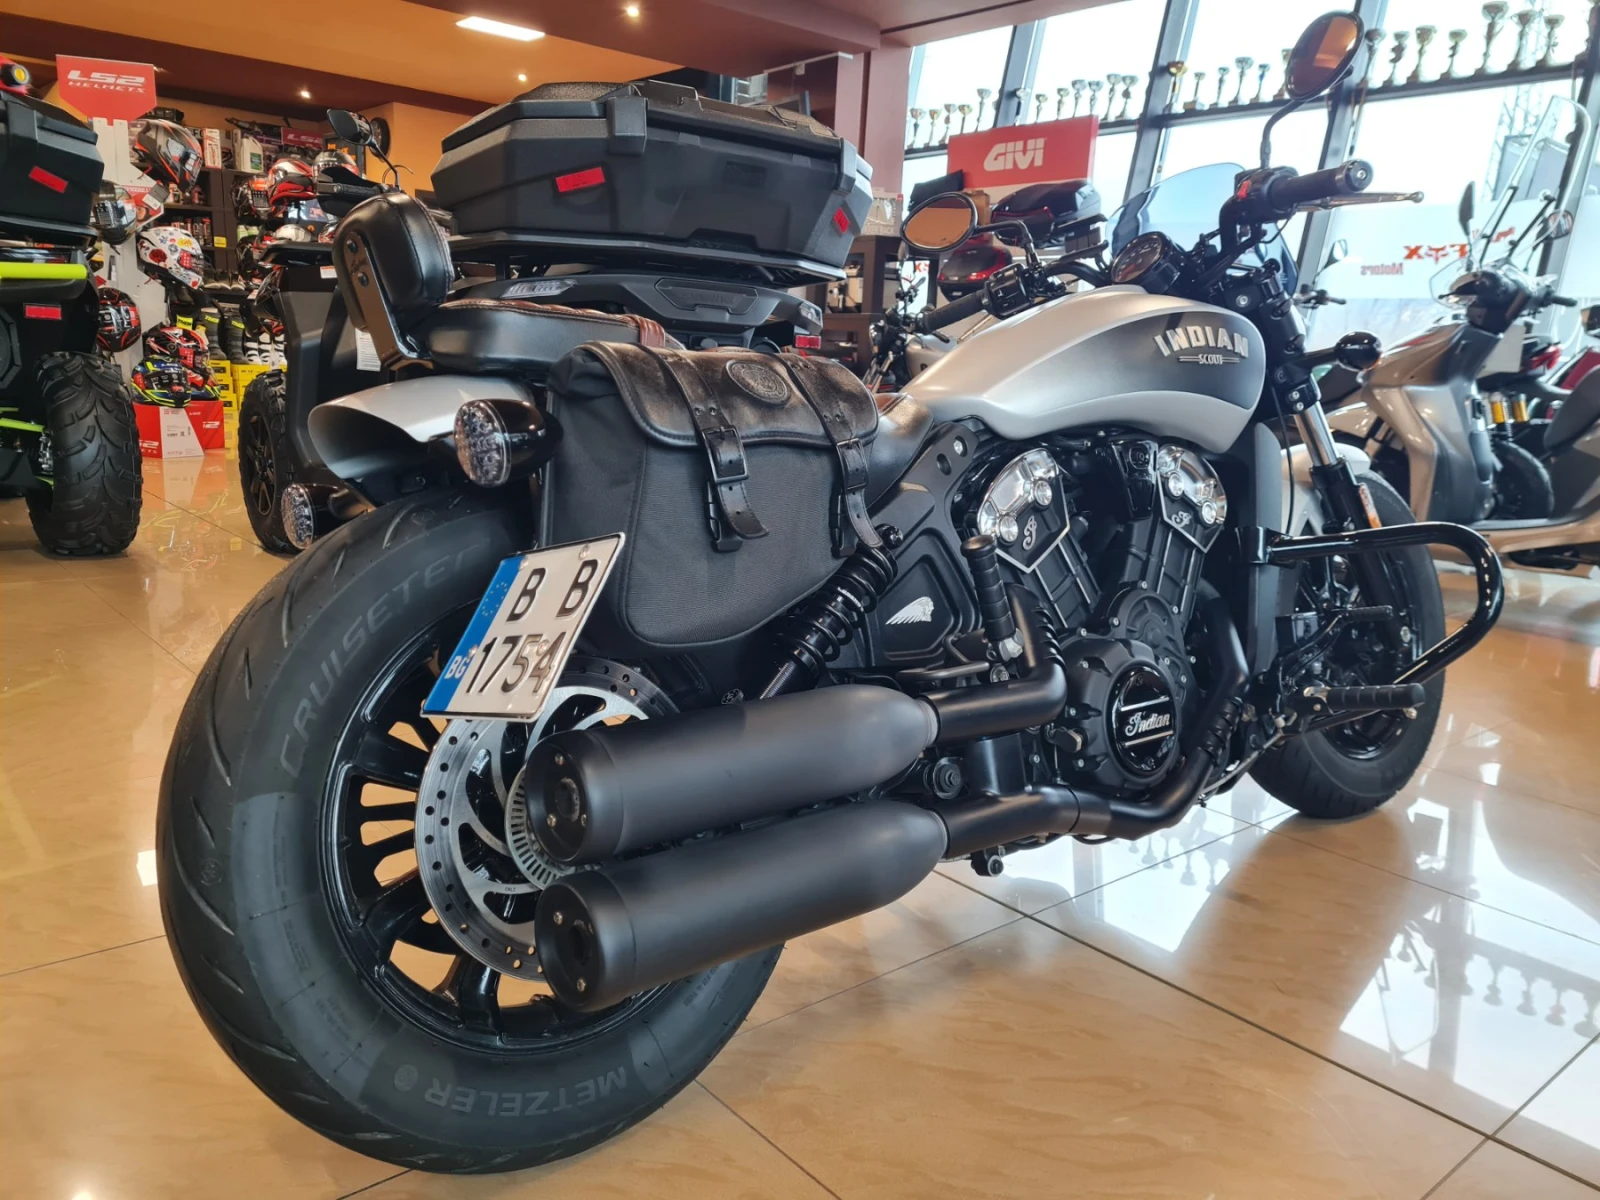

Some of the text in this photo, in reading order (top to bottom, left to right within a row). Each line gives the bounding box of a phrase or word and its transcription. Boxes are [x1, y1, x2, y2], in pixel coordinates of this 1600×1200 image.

[67, 69, 145, 87] LS2
[68, 81, 145, 93] HELMETS
[983, 138, 1045, 172] GIVI
[1153, 325, 1249, 358] INDIAN
[1198, 353, 1223, 365] SCOUT
[506, 559, 599, 623] B B
[444, 655, 471, 680] BG
[465, 631, 567, 694] 1754
[1124, 711, 1171, 737] Indian
[424, 1065, 627, 1117] METZELER
